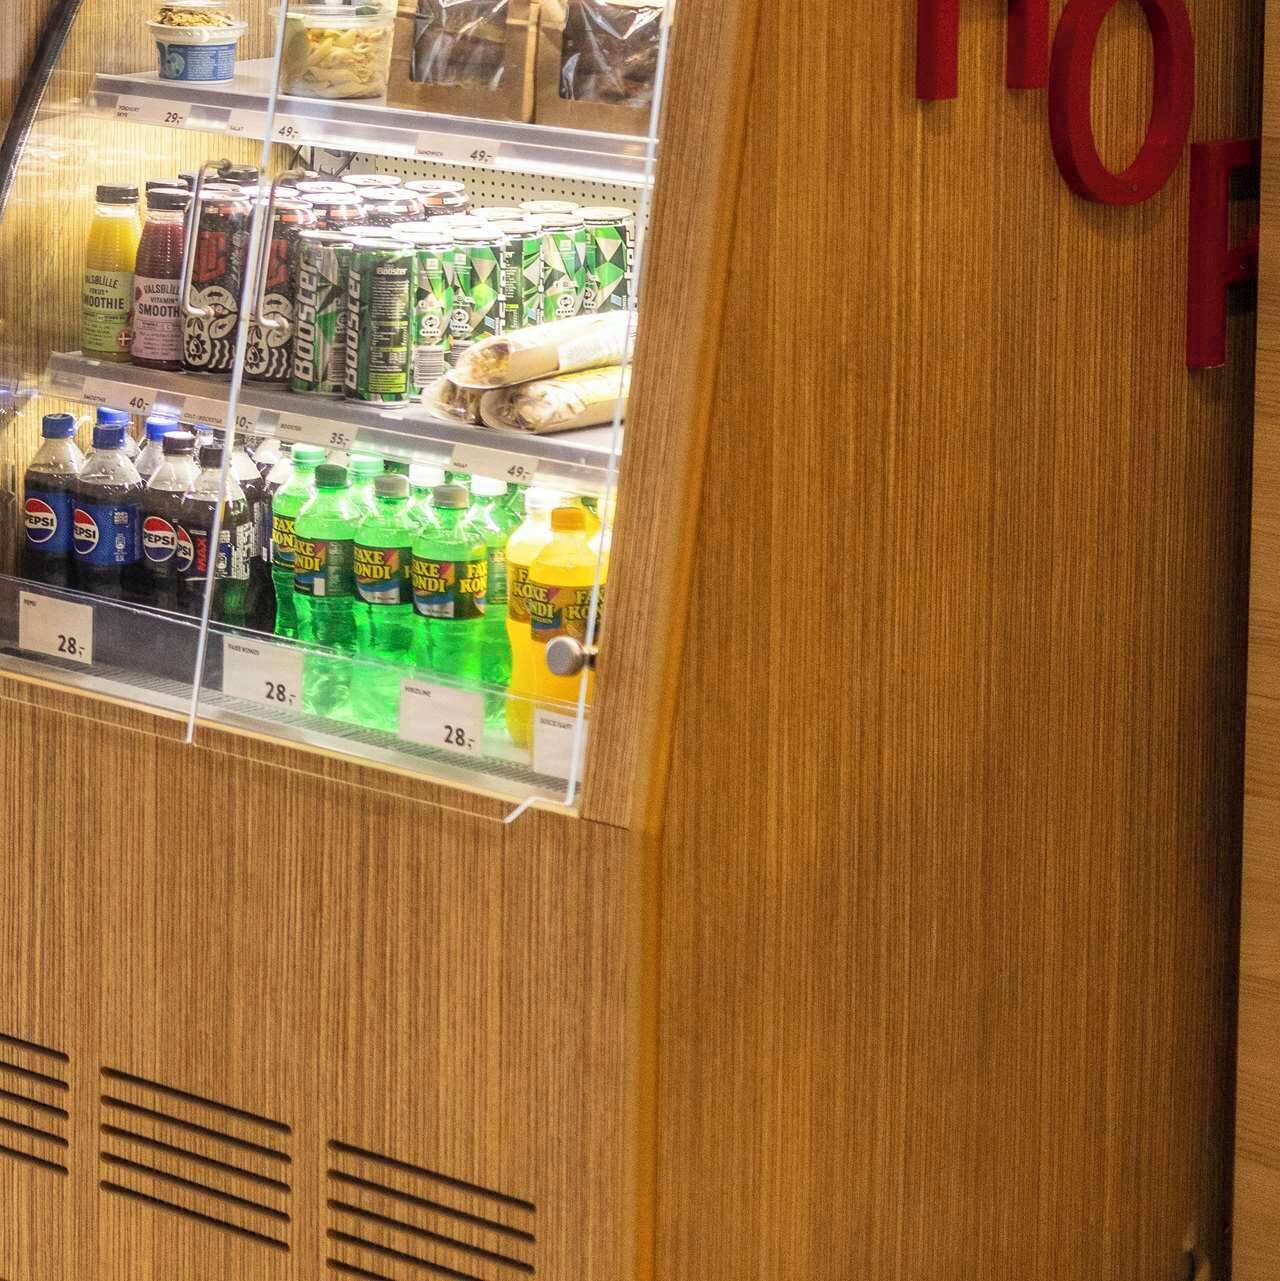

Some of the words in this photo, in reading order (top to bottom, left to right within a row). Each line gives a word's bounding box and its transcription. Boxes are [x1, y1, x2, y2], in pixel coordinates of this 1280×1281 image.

[138, 303, 181, 318] SMOOTH
[57, 634, 85, 657] 28,-
[265, 681, 297, 704] 28,-
[444, 724, 476, 750] 28,-
